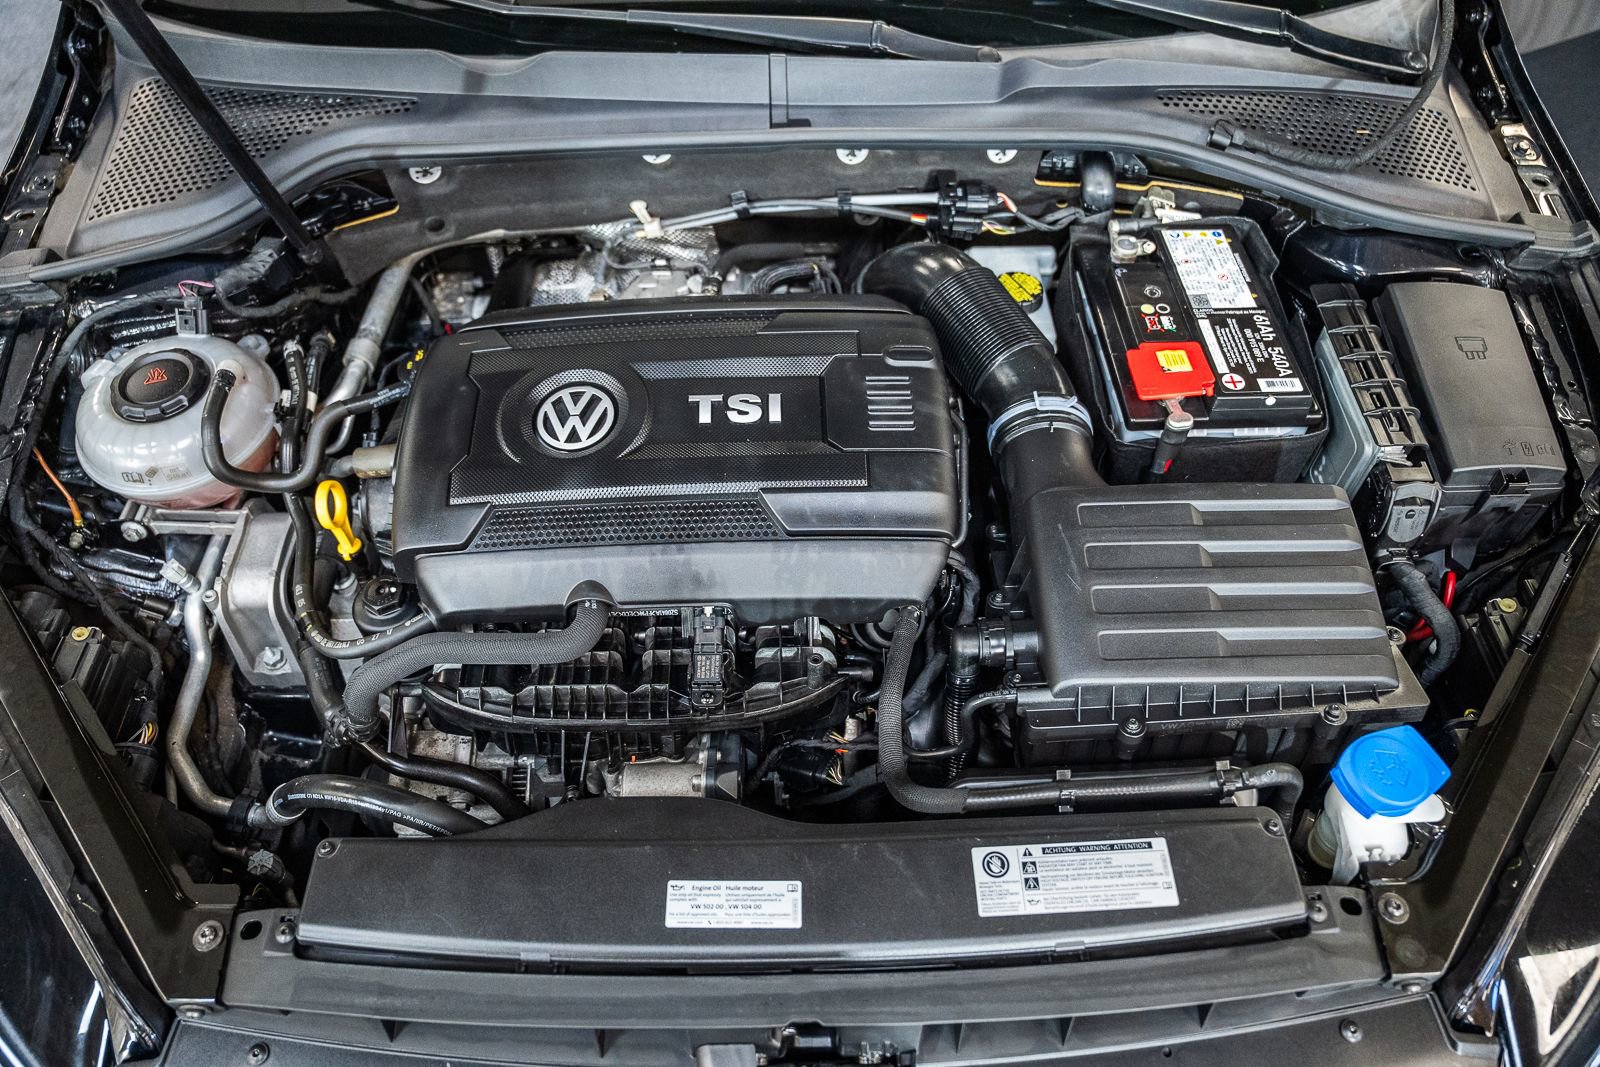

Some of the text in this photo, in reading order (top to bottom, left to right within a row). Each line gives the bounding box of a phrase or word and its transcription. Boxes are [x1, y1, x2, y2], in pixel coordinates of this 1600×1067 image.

[1253, 314, 1293, 377] 61Ah 540A
[688, 393, 782, 424] TSI
[1044, 842, 1149, 854] ACHTUNG WARNING ATTENTION
